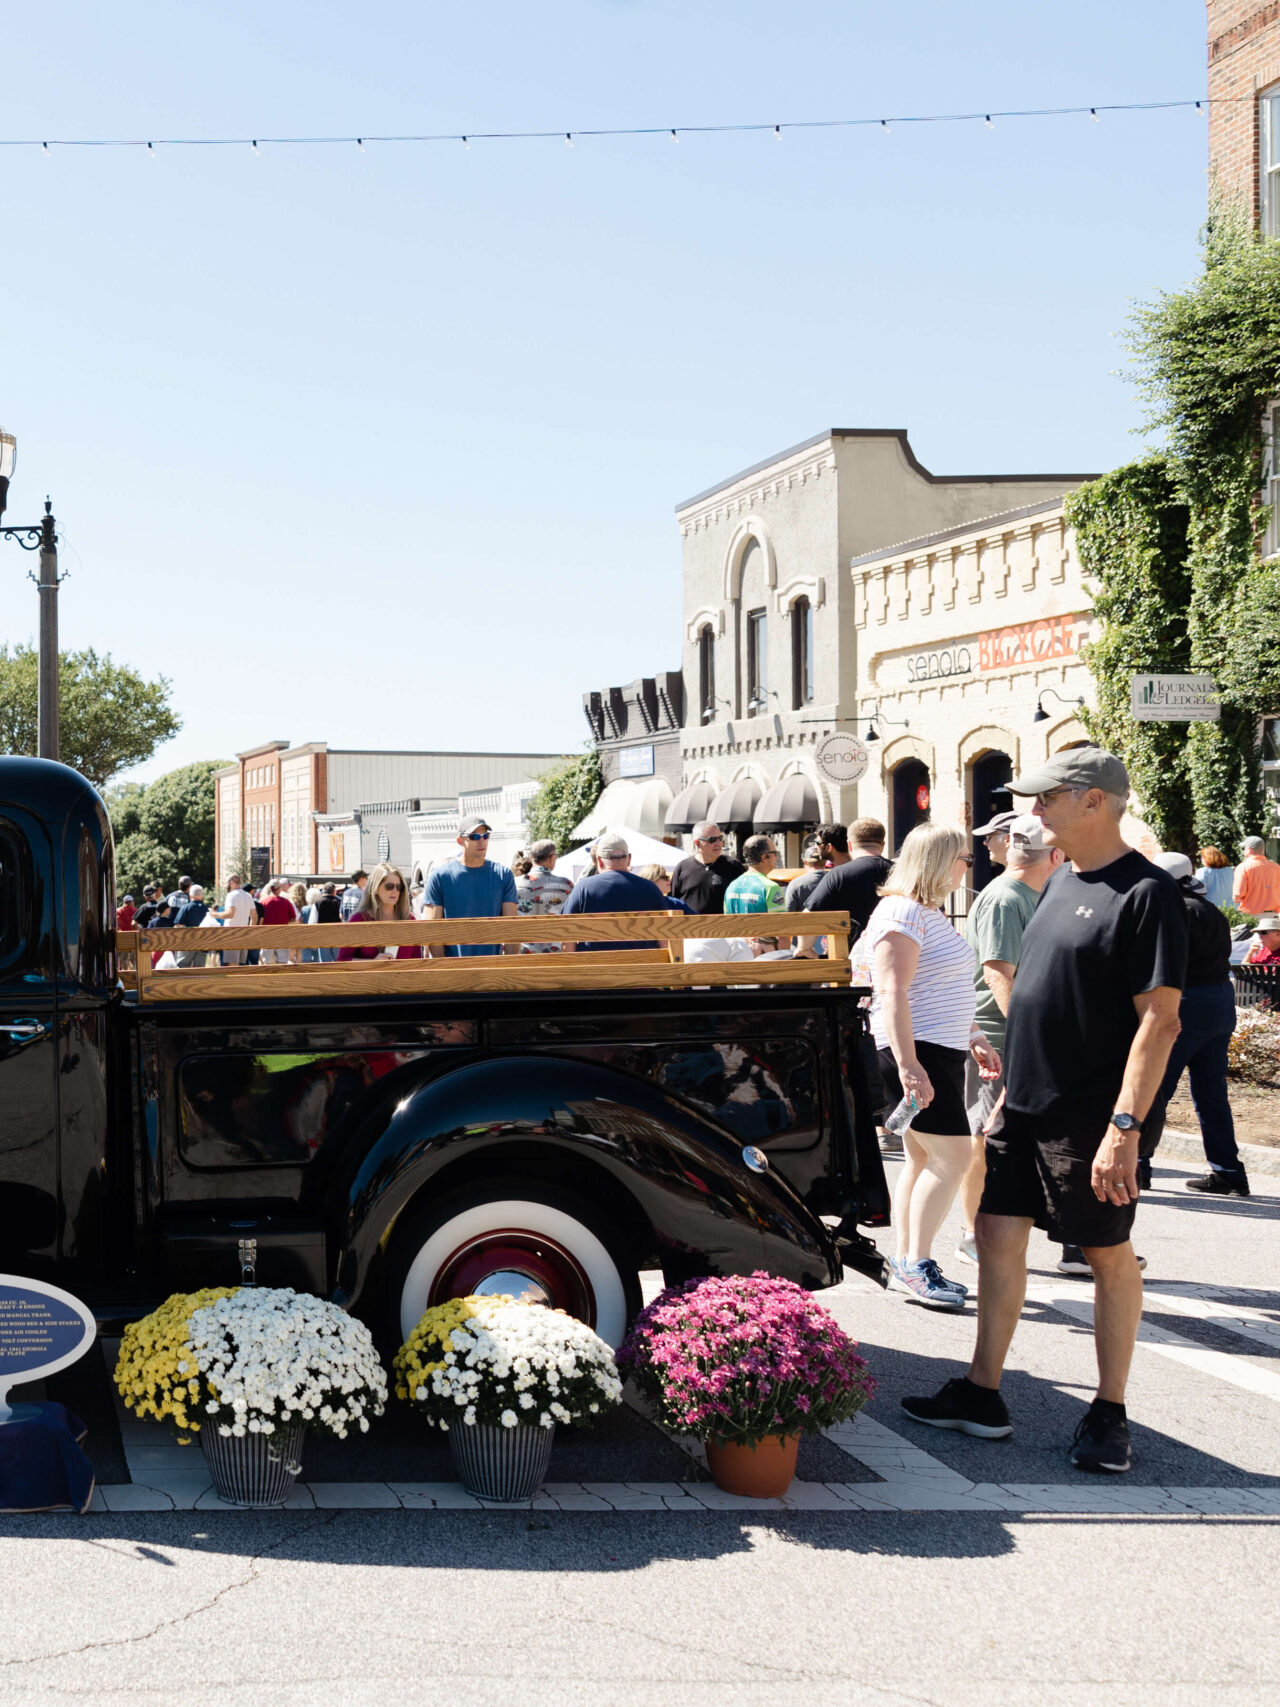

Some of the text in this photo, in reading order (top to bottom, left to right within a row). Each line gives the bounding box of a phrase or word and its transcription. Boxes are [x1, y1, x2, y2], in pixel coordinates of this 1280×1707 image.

[907, 614, 1075, 683] senoia BICYCLE
[1157, 680, 1216, 695] JOURNALS
[816, 748, 868, 764] senoia
